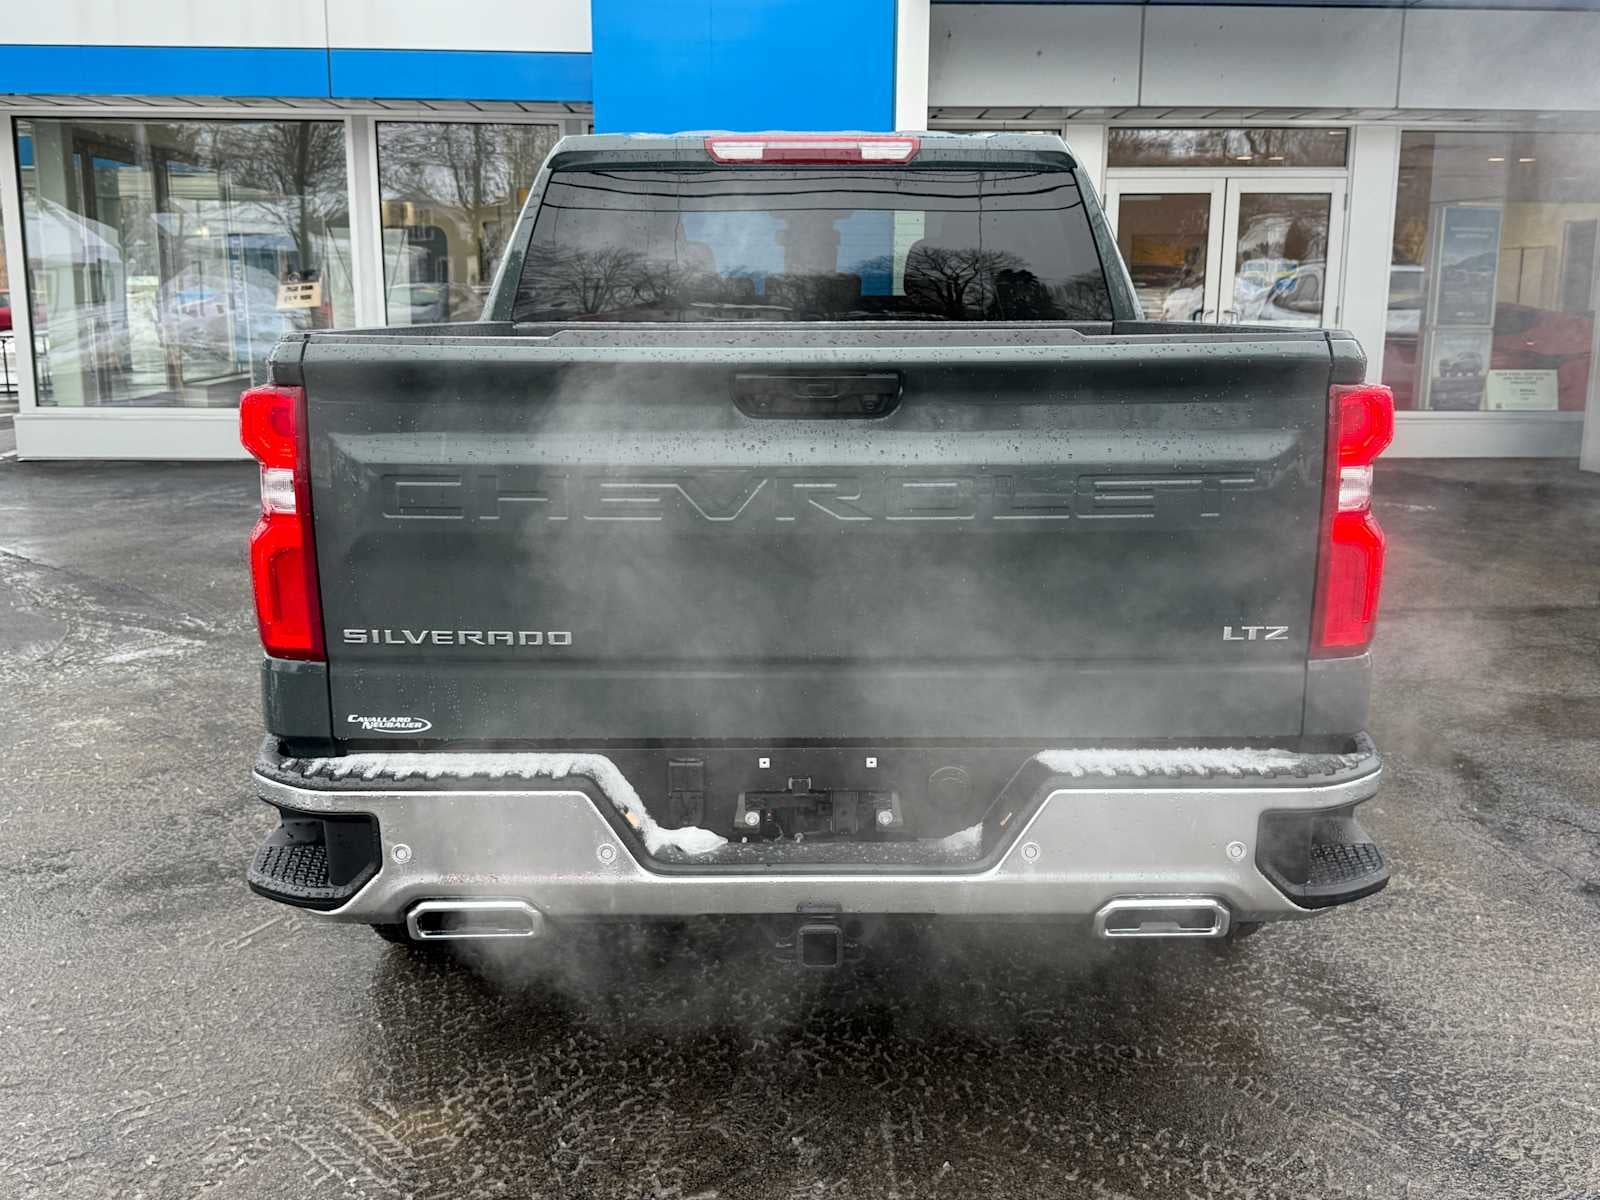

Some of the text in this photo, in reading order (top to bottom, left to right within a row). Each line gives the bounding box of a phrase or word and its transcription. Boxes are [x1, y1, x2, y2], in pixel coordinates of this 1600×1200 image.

[382, 473, 1255, 522] CHEVROLET
[343, 629, 572, 646] SILVERADO
[1222, 625, 1289, 641] LTZ
[361, 721, 423, 730] NEUBAUER
